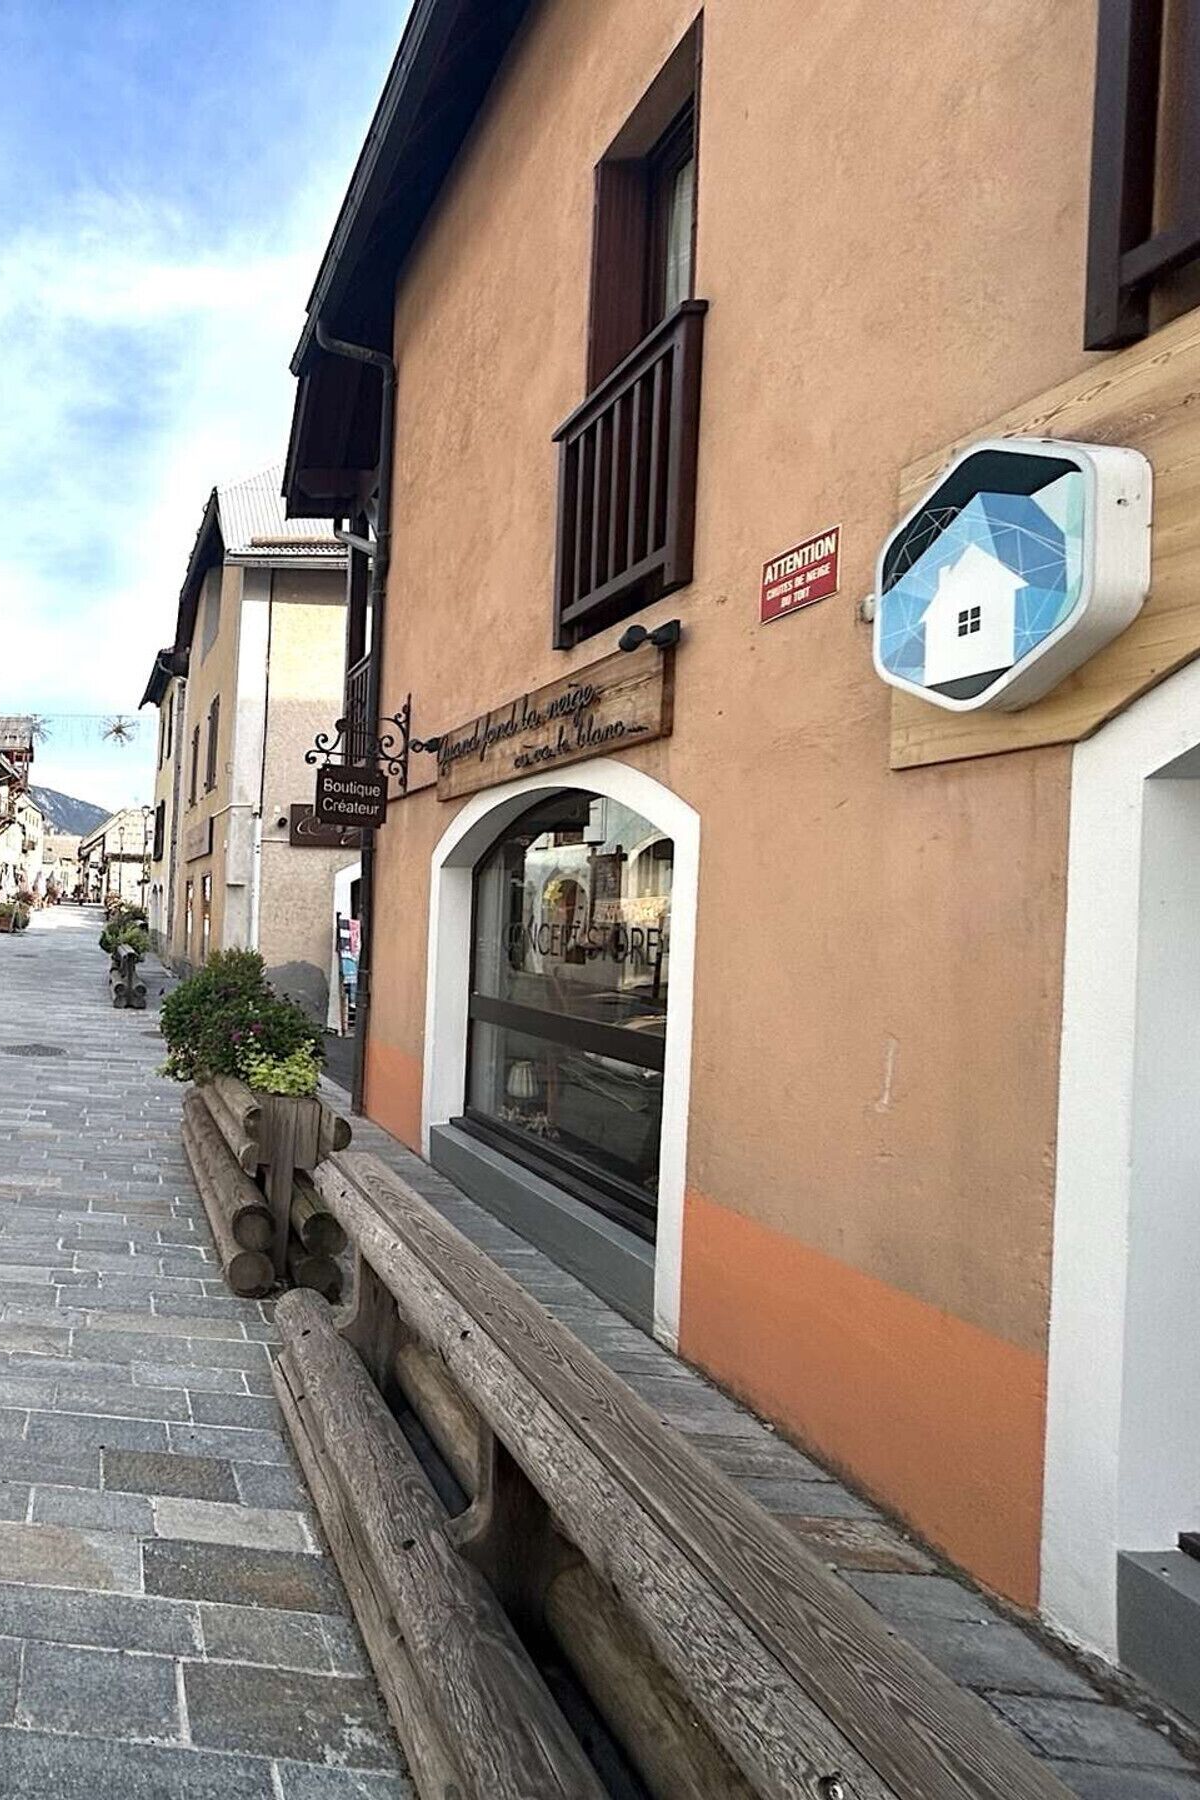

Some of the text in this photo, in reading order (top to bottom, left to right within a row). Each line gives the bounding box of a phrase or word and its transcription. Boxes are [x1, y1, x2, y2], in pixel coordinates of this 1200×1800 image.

[764, 533, 837, 585] ATTENTION
[521, 693, 543, 731] la
[546, 683, 597, 728] neige
[322, 777, 381, 798] Boutique
[322, 797, 380, 815] Créateur
[586, 925, 663, 967] STORE
